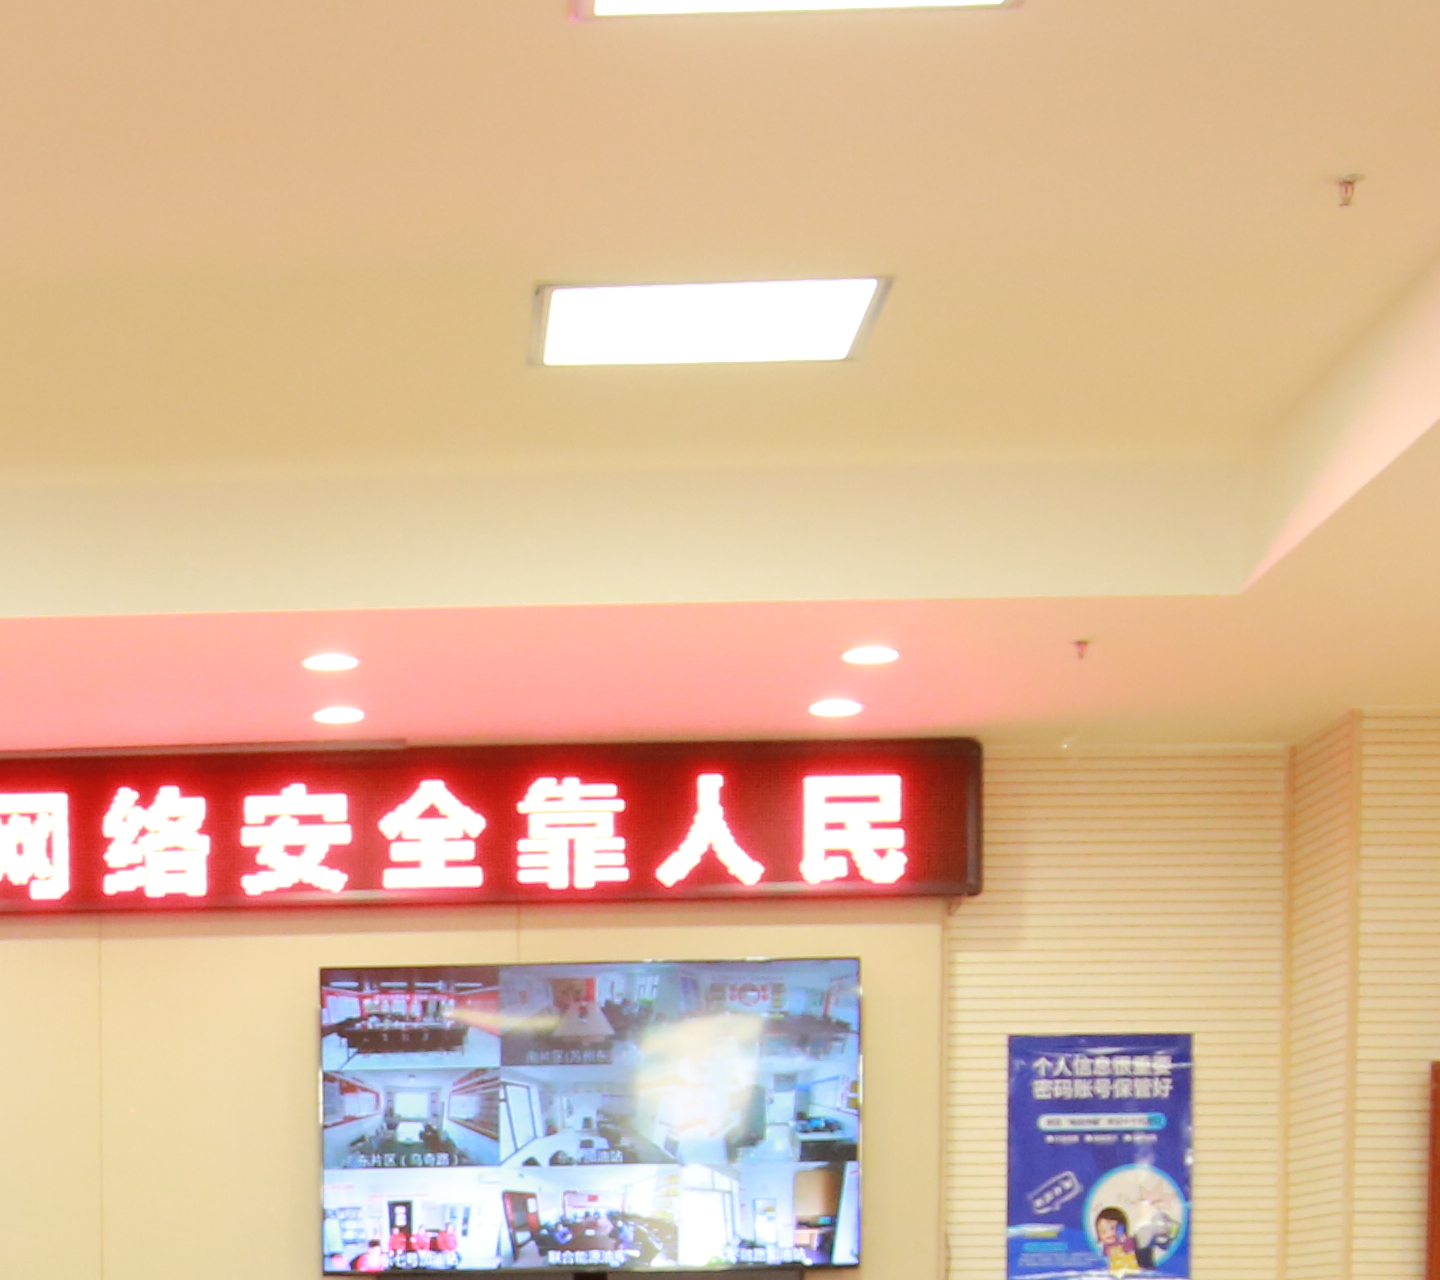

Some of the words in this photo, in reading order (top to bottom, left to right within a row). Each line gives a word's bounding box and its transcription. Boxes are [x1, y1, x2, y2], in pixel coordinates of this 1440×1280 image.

[1032, 1055, 1172, 1076] 个人信息很重要
